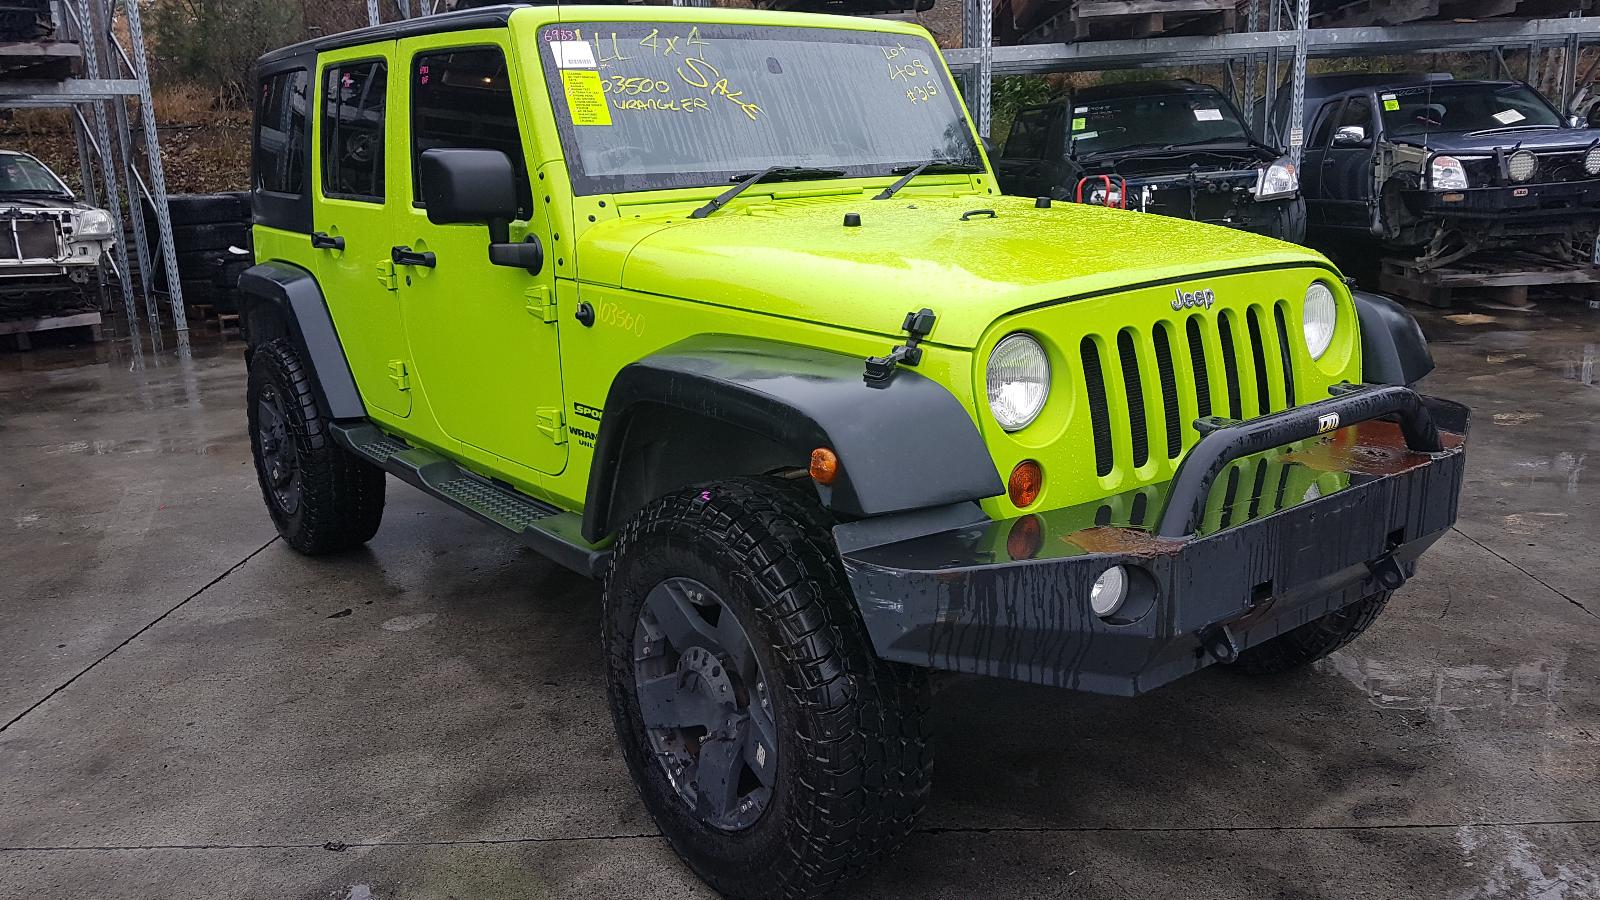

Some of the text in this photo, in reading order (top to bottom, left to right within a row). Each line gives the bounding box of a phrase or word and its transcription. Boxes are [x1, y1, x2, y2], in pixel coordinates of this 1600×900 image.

[1171, 288, 1215, 311] Jeep
[597, 295, 646, 338] 103500
[576, 405, 602, 419] SPO
[569, 426, 598, 440] WRAN
[578, 439, 595, 449] UNL
